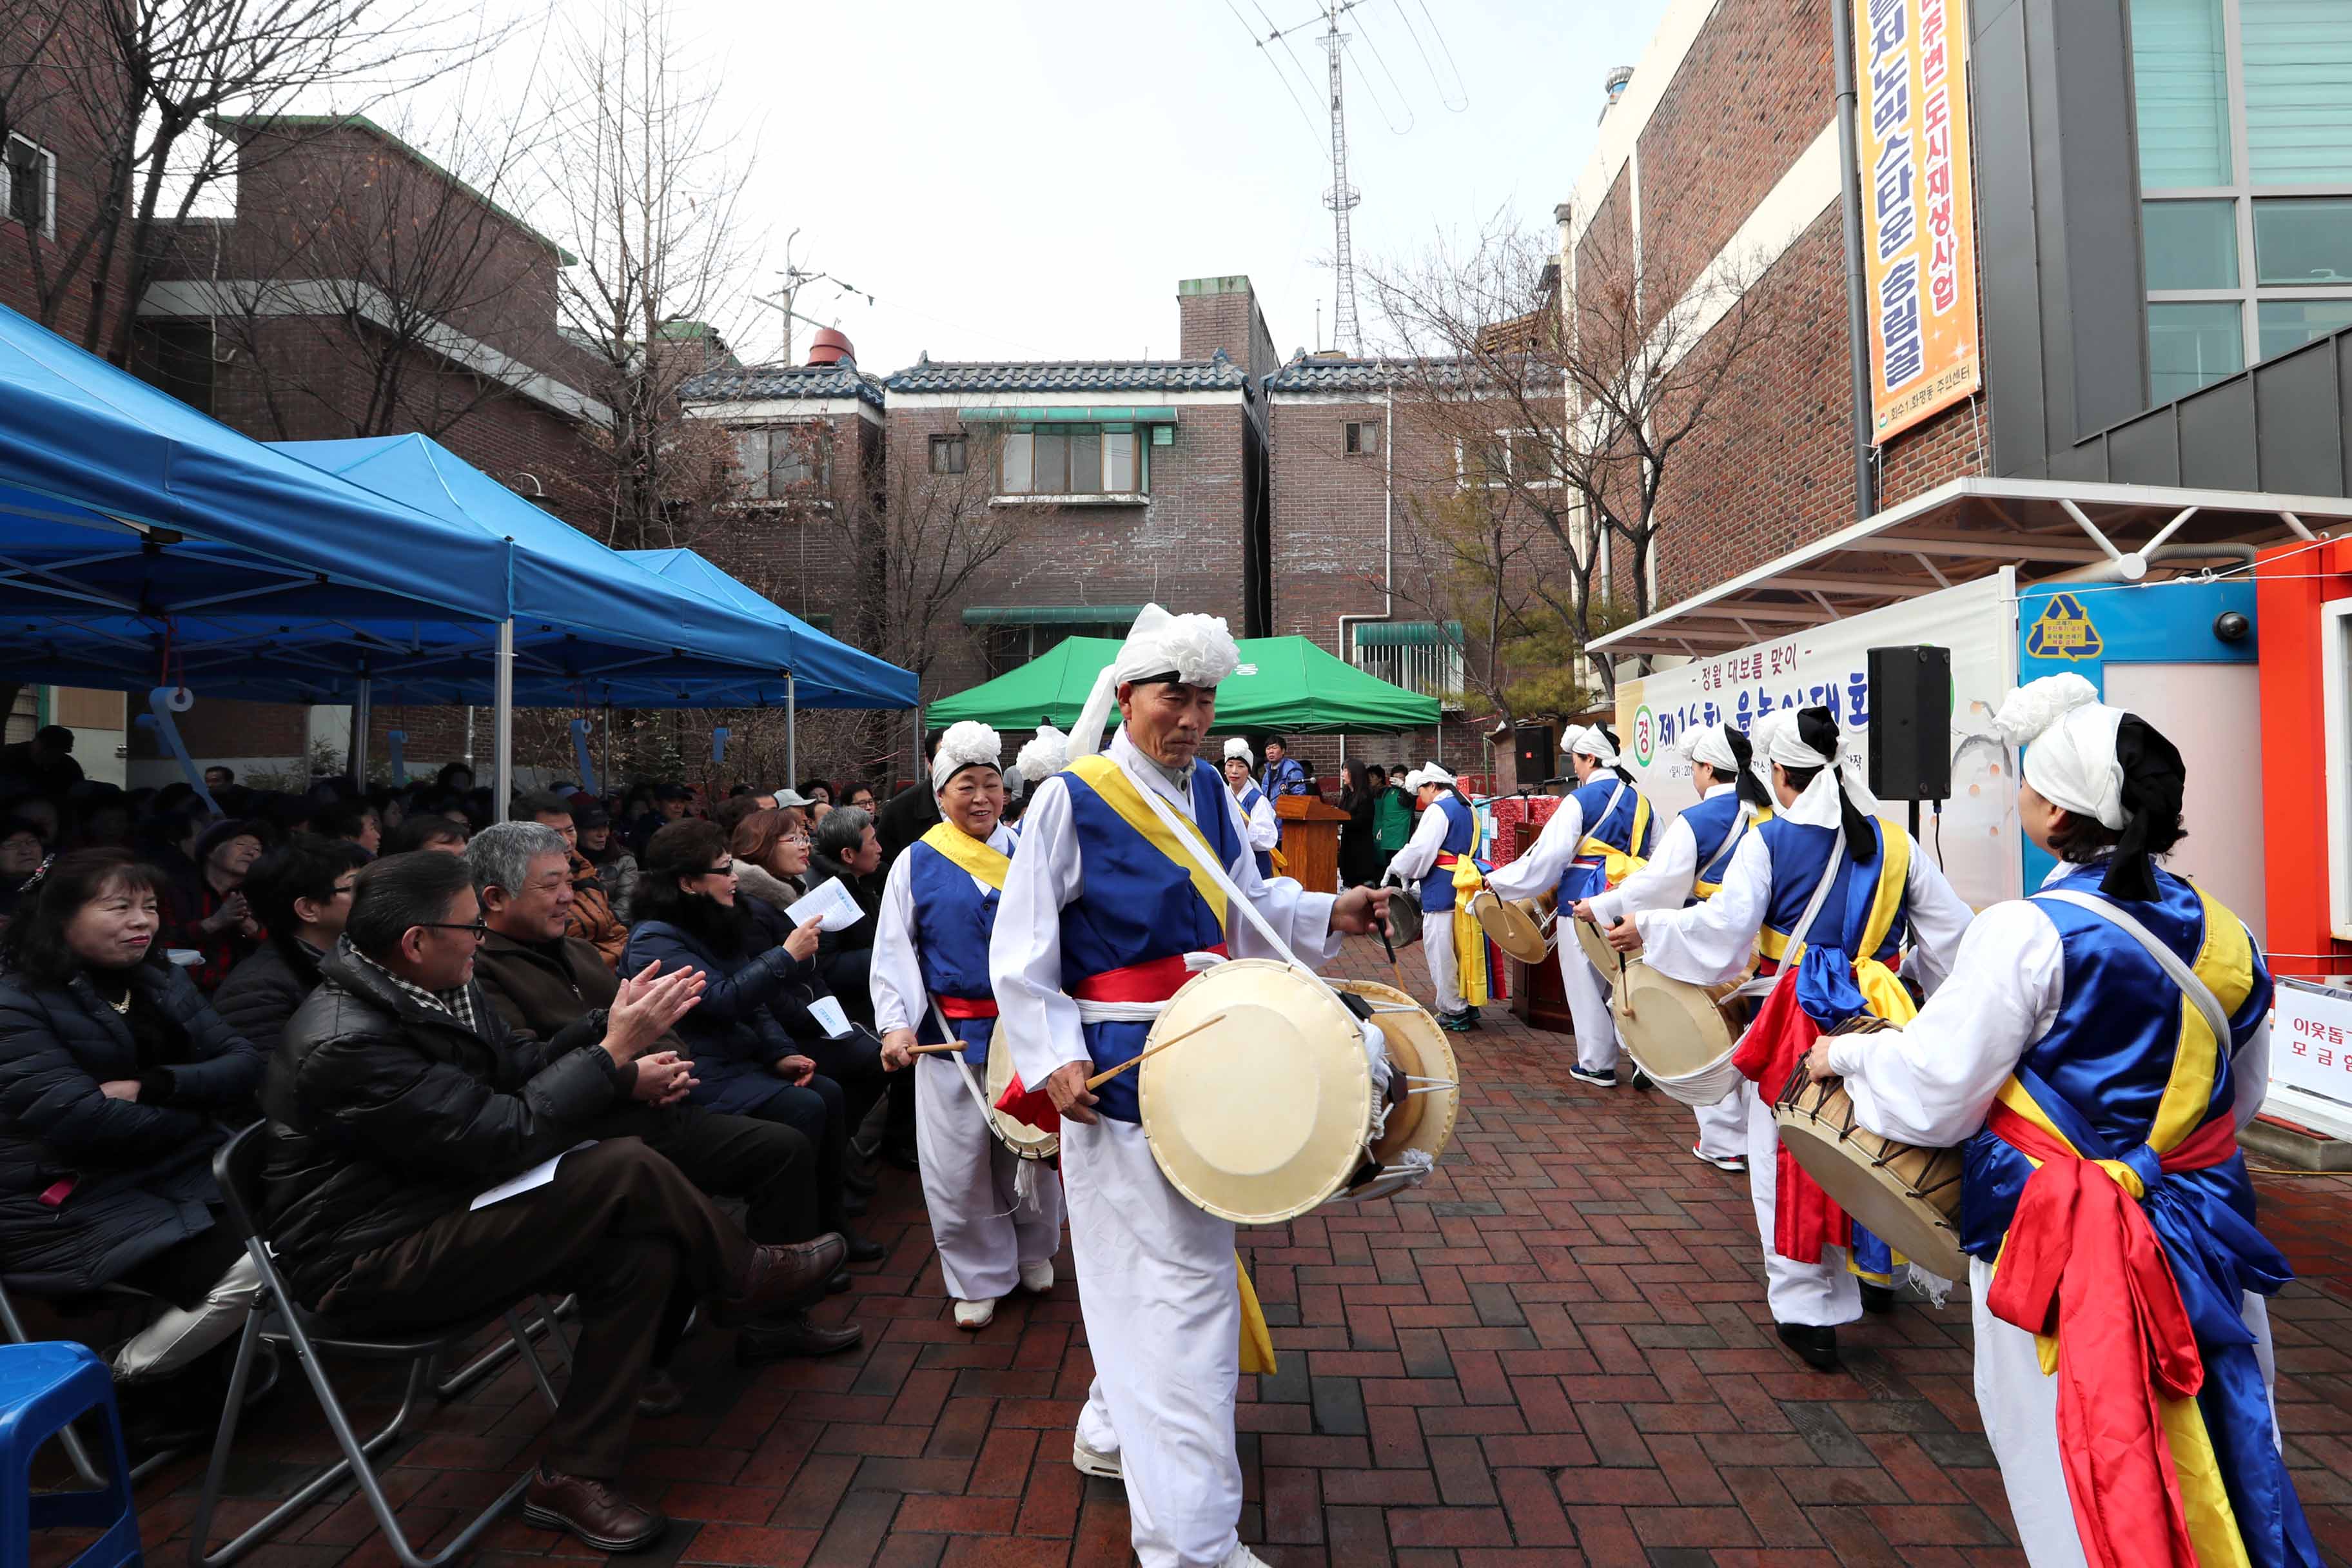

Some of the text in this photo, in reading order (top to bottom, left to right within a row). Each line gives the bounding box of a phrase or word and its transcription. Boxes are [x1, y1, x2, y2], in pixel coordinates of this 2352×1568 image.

[1922, 0, 1955, 311] 주변 도시재생사업
[1882, 259, 1920, 387] 송림골
[1937, 364, 1970, 395] 주민센터
[1701, 662, 1722, 691] 정월
[1727, 652, 1763, 684] 대보름
[1770, 642, 1797, 676] 맞이
[1638, 718, 1649, 754] 경
[2293, 1017, 2352, 1045] 이웃돕
